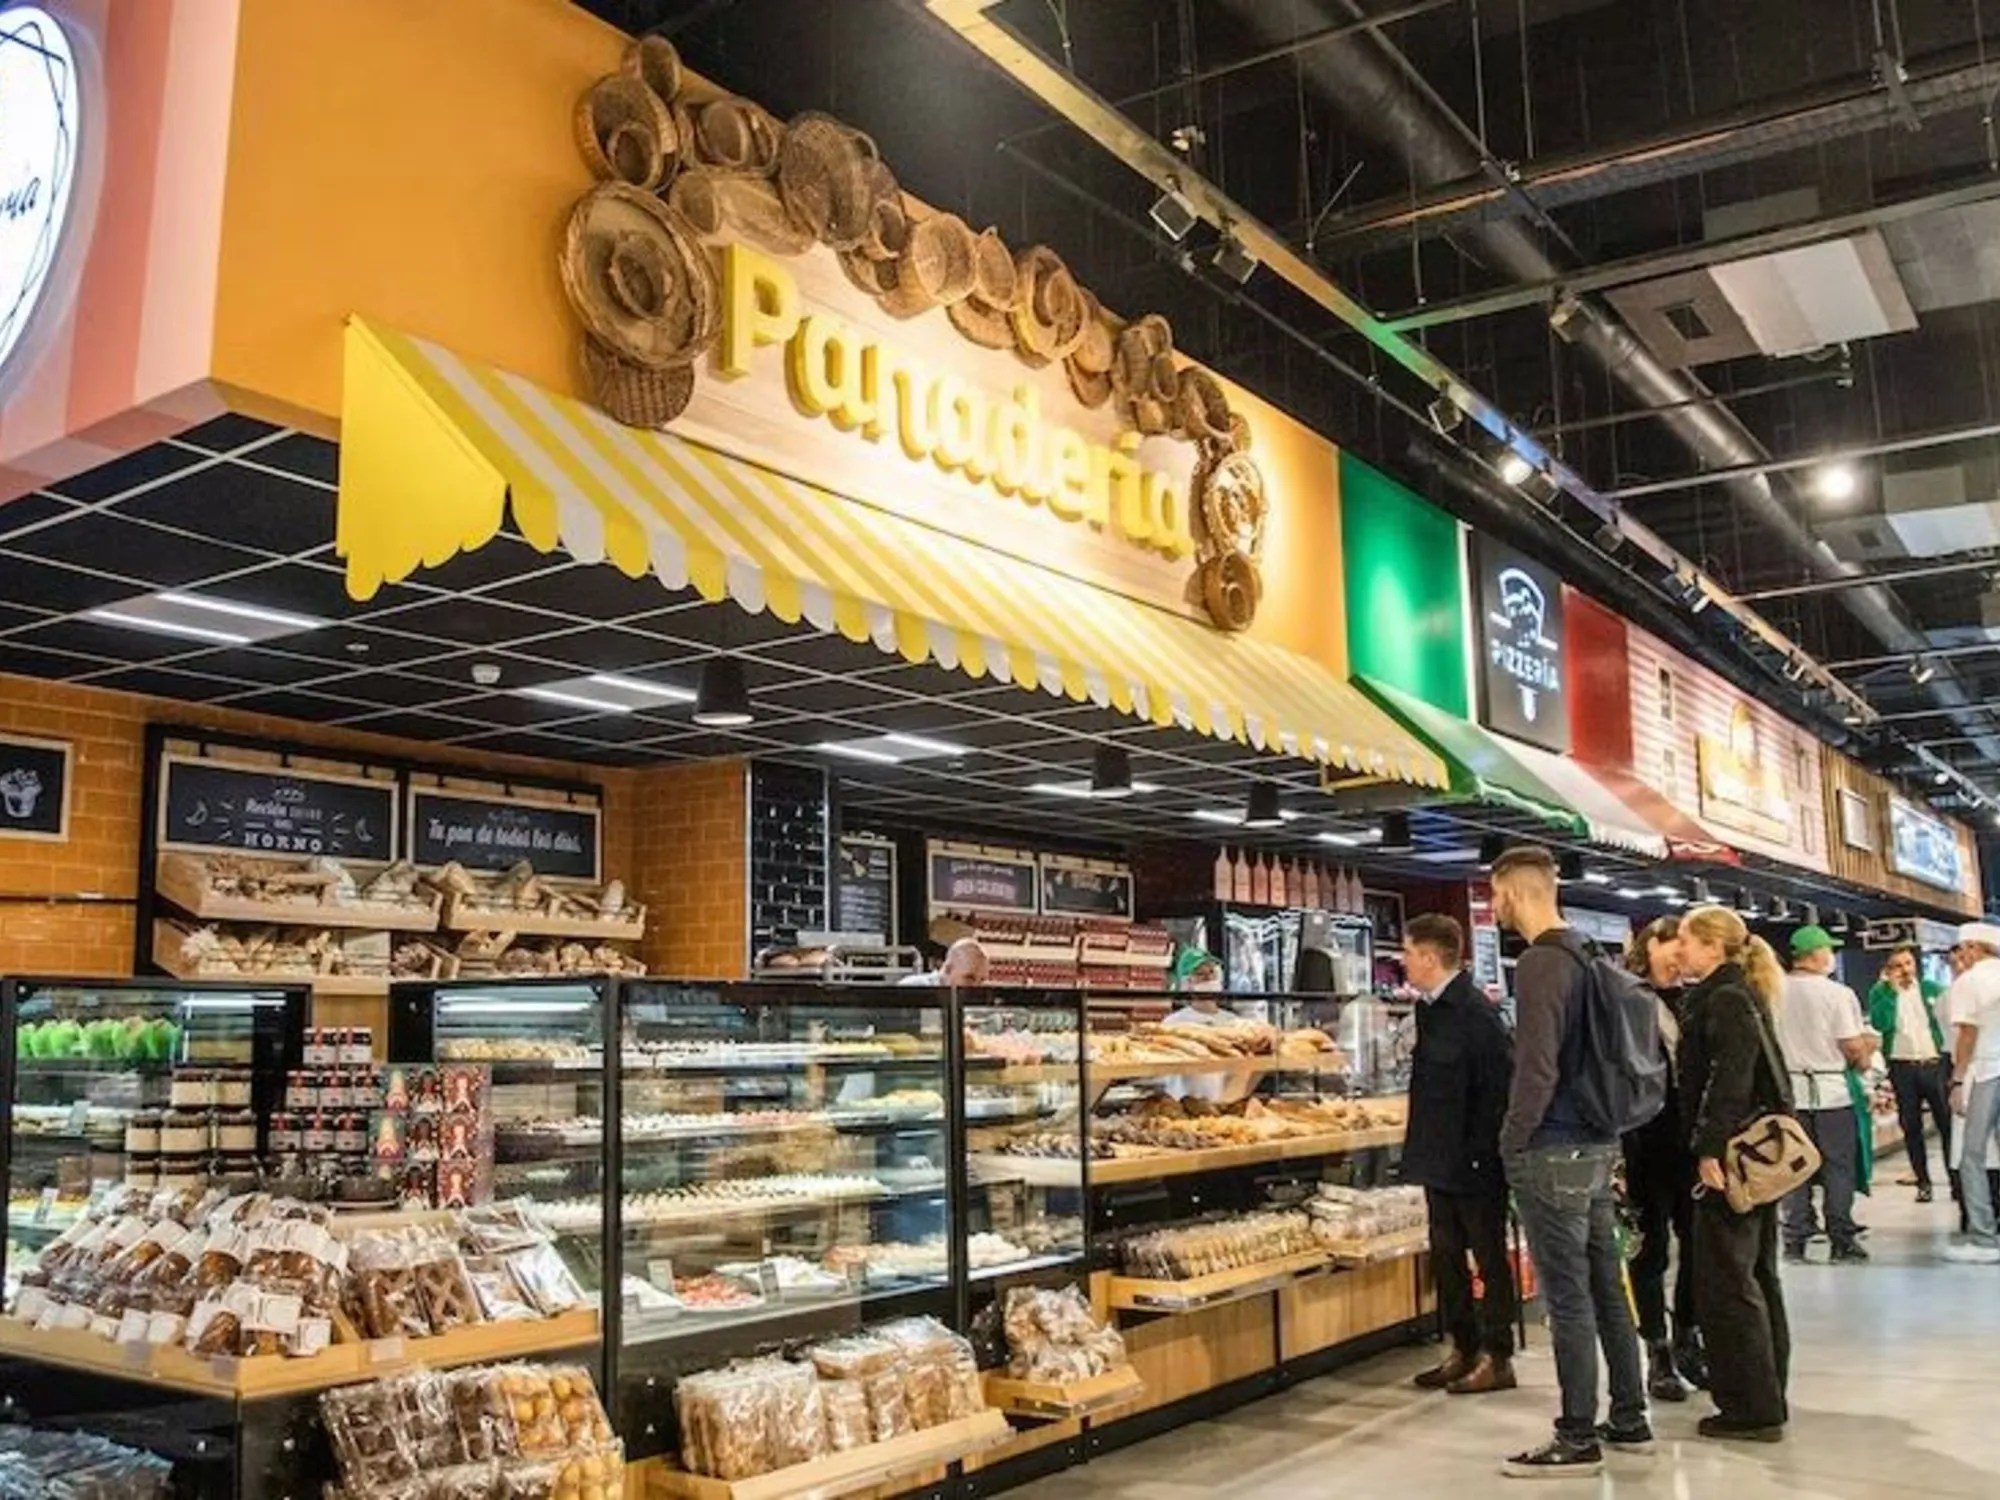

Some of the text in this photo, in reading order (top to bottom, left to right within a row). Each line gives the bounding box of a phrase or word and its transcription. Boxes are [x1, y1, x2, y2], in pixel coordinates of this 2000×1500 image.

[244, 831, 323, 853] HORNO
[445, 825, 473, 847] pan
[475, 824, 494, 845] de
